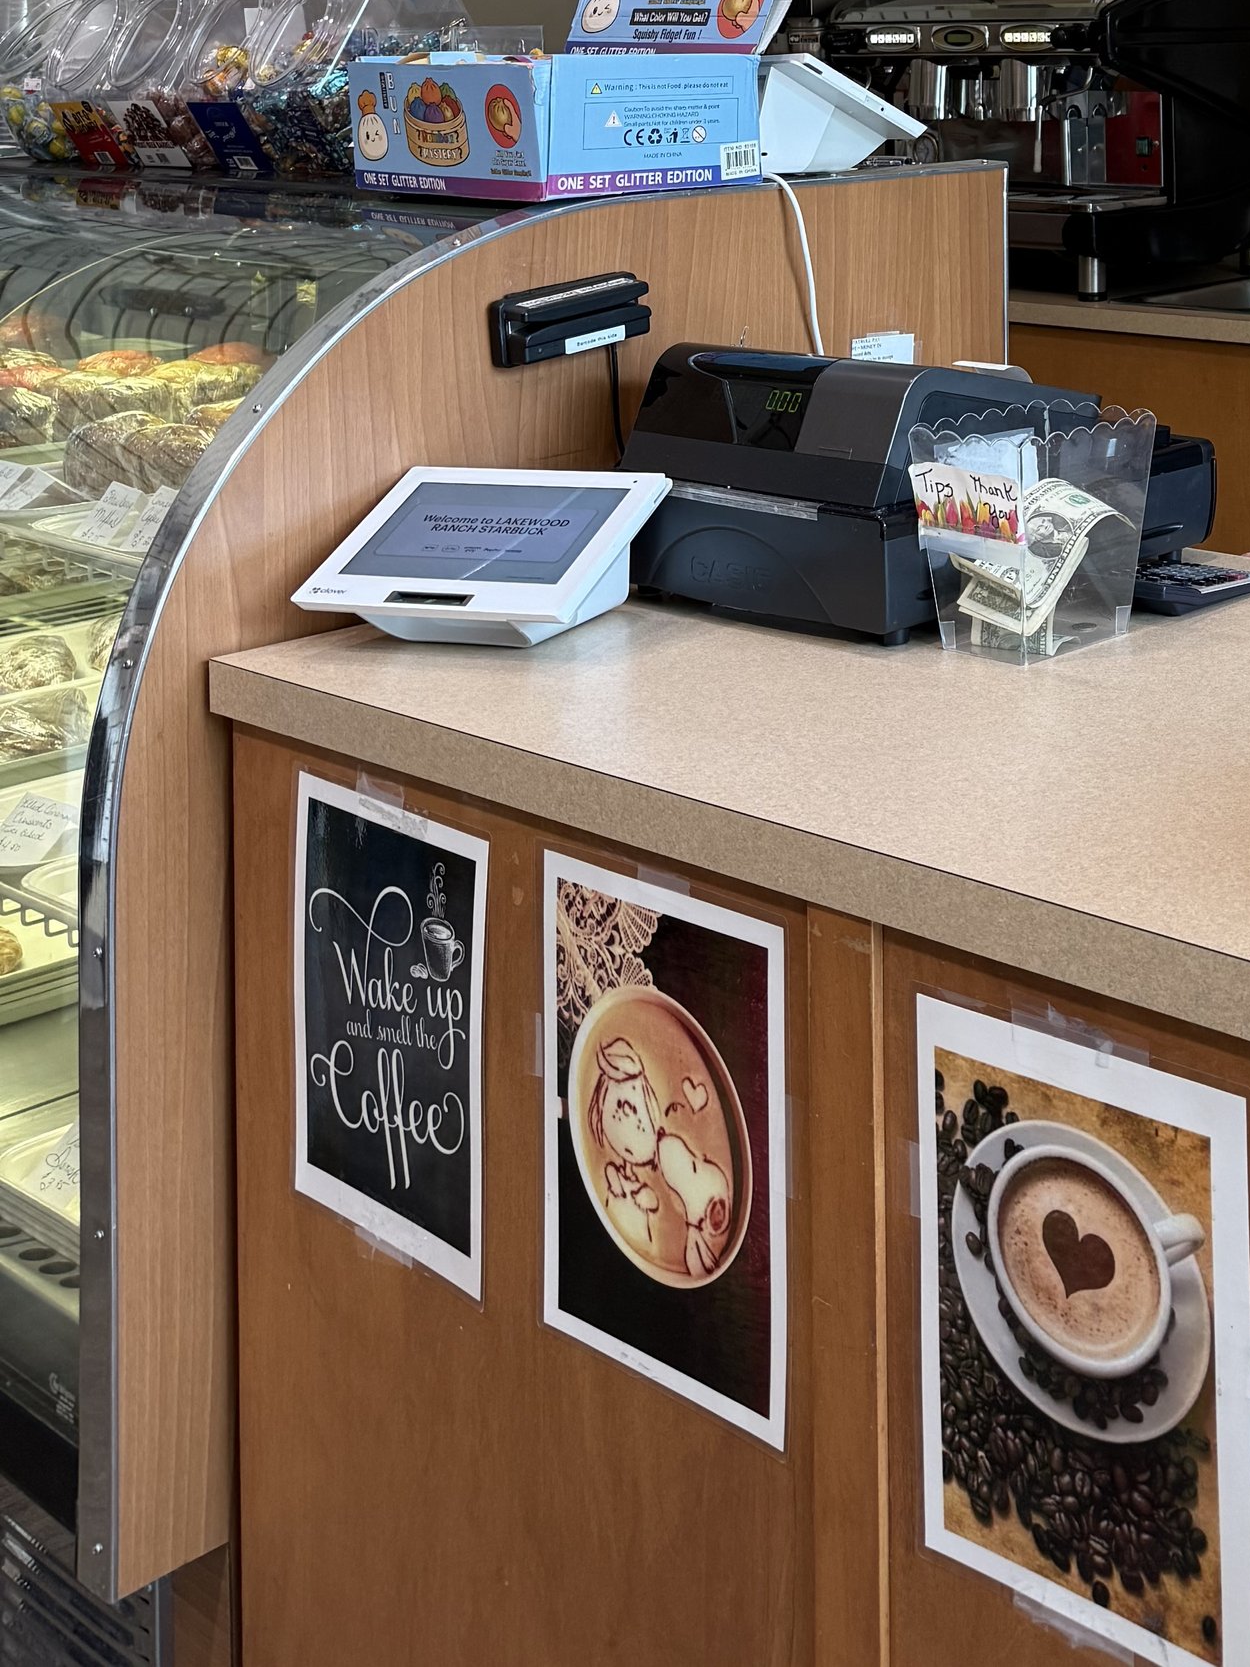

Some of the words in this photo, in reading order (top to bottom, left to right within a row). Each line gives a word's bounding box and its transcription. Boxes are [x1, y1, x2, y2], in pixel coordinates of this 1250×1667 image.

[649, 11, 667, 23] Color
[667, 12, 679, 22] Will
[680, 12, 692, 22] You
[632, 28, 660, 41] Squishy
[660, 28, 682, 41] Fidget
[683, 29, 696, 39] Fun
[604, 83, 634, 92] Warning
[363, 172, 377, 185] ONE
[378, 173, 390, 186] SET
[391, 173, 418, 189] GLITTER
[419, 176, 447, 191] EDITION
[557, 176, 584, 191] ONE
[589, 175, 611, 189] SET
[616, 172, 663, 186] GLITTER
[667, 168, 713, 184] EDITION
[915, 467, 954, 503] Tips
[970, 473, 1018, 502] Thank
[423, 513, 480, 525] Welcome
[480, 514, 494, 525] to
[494, 516, 571, 528] LAKEWOOD
[430, 523, 479, 534] RANCH
[479, 525, 549, 536] STARBUCK
[308, 885, 418, 1014] Wake
[426, 984, 466, 1071] up
[345, 1008, 373, 1040] and
[376, 1014, 412, 1048] smell
[415, 1016, 438, 1051] the
[310, 1039, 466, 1190] Coffee
